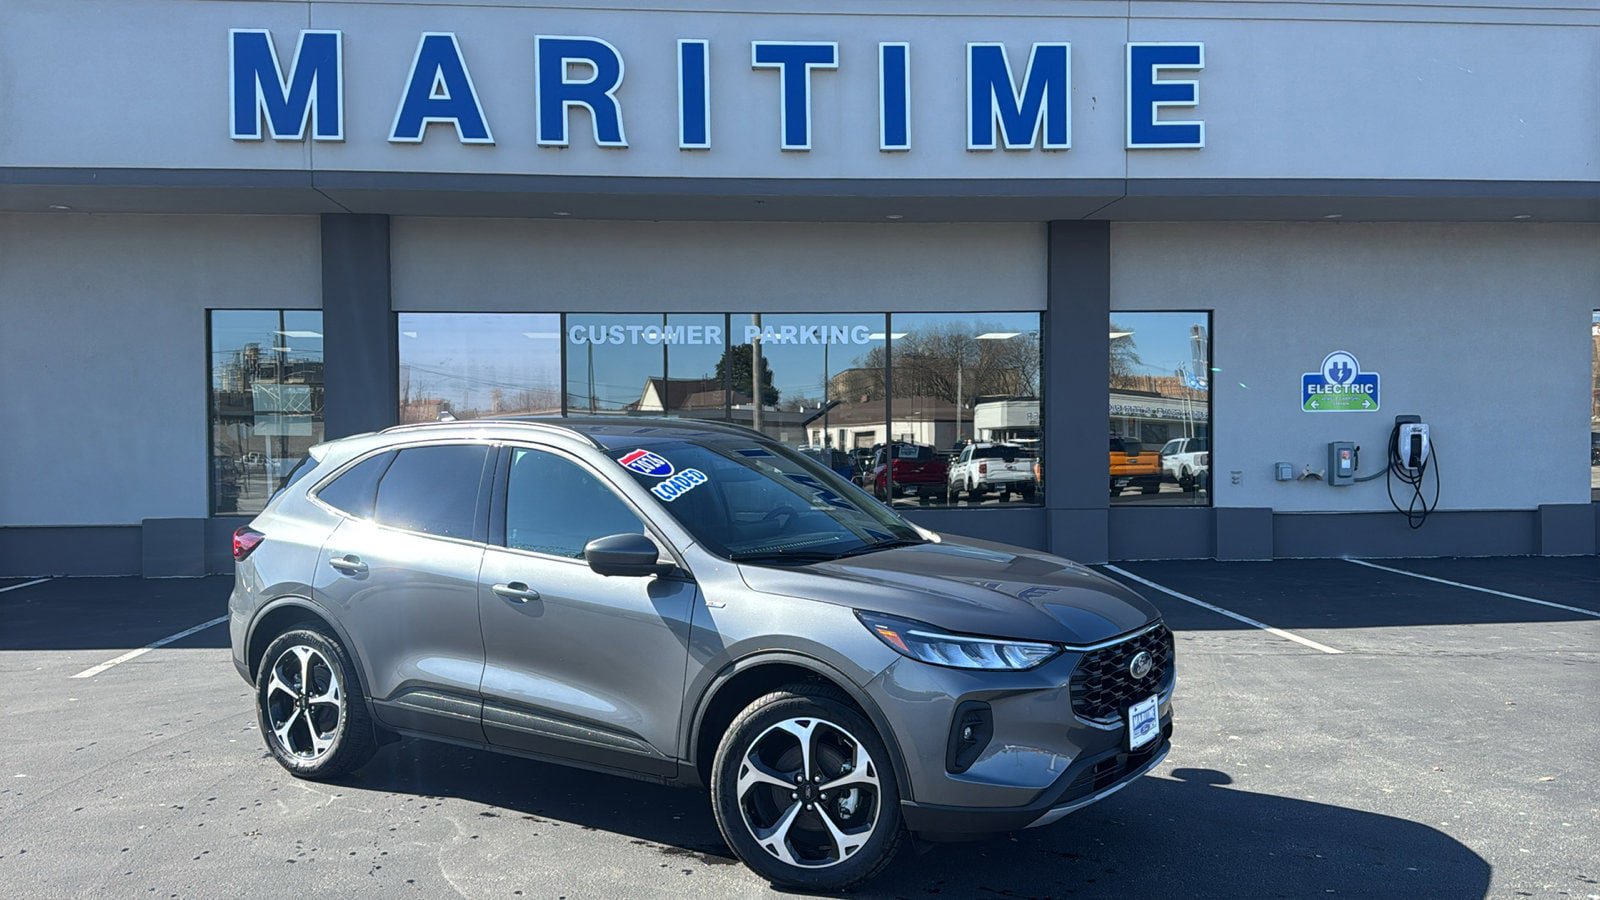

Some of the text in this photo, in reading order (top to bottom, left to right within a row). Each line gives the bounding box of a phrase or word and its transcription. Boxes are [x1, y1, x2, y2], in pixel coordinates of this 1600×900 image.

[228, 28, 1205, 151] MARITIME
[568, 325, 870, 345] CUSTOMER PARKING
[1307, 384, 1374, 394] ELECTRIC
[654, 469, 706, 500] LOADED
